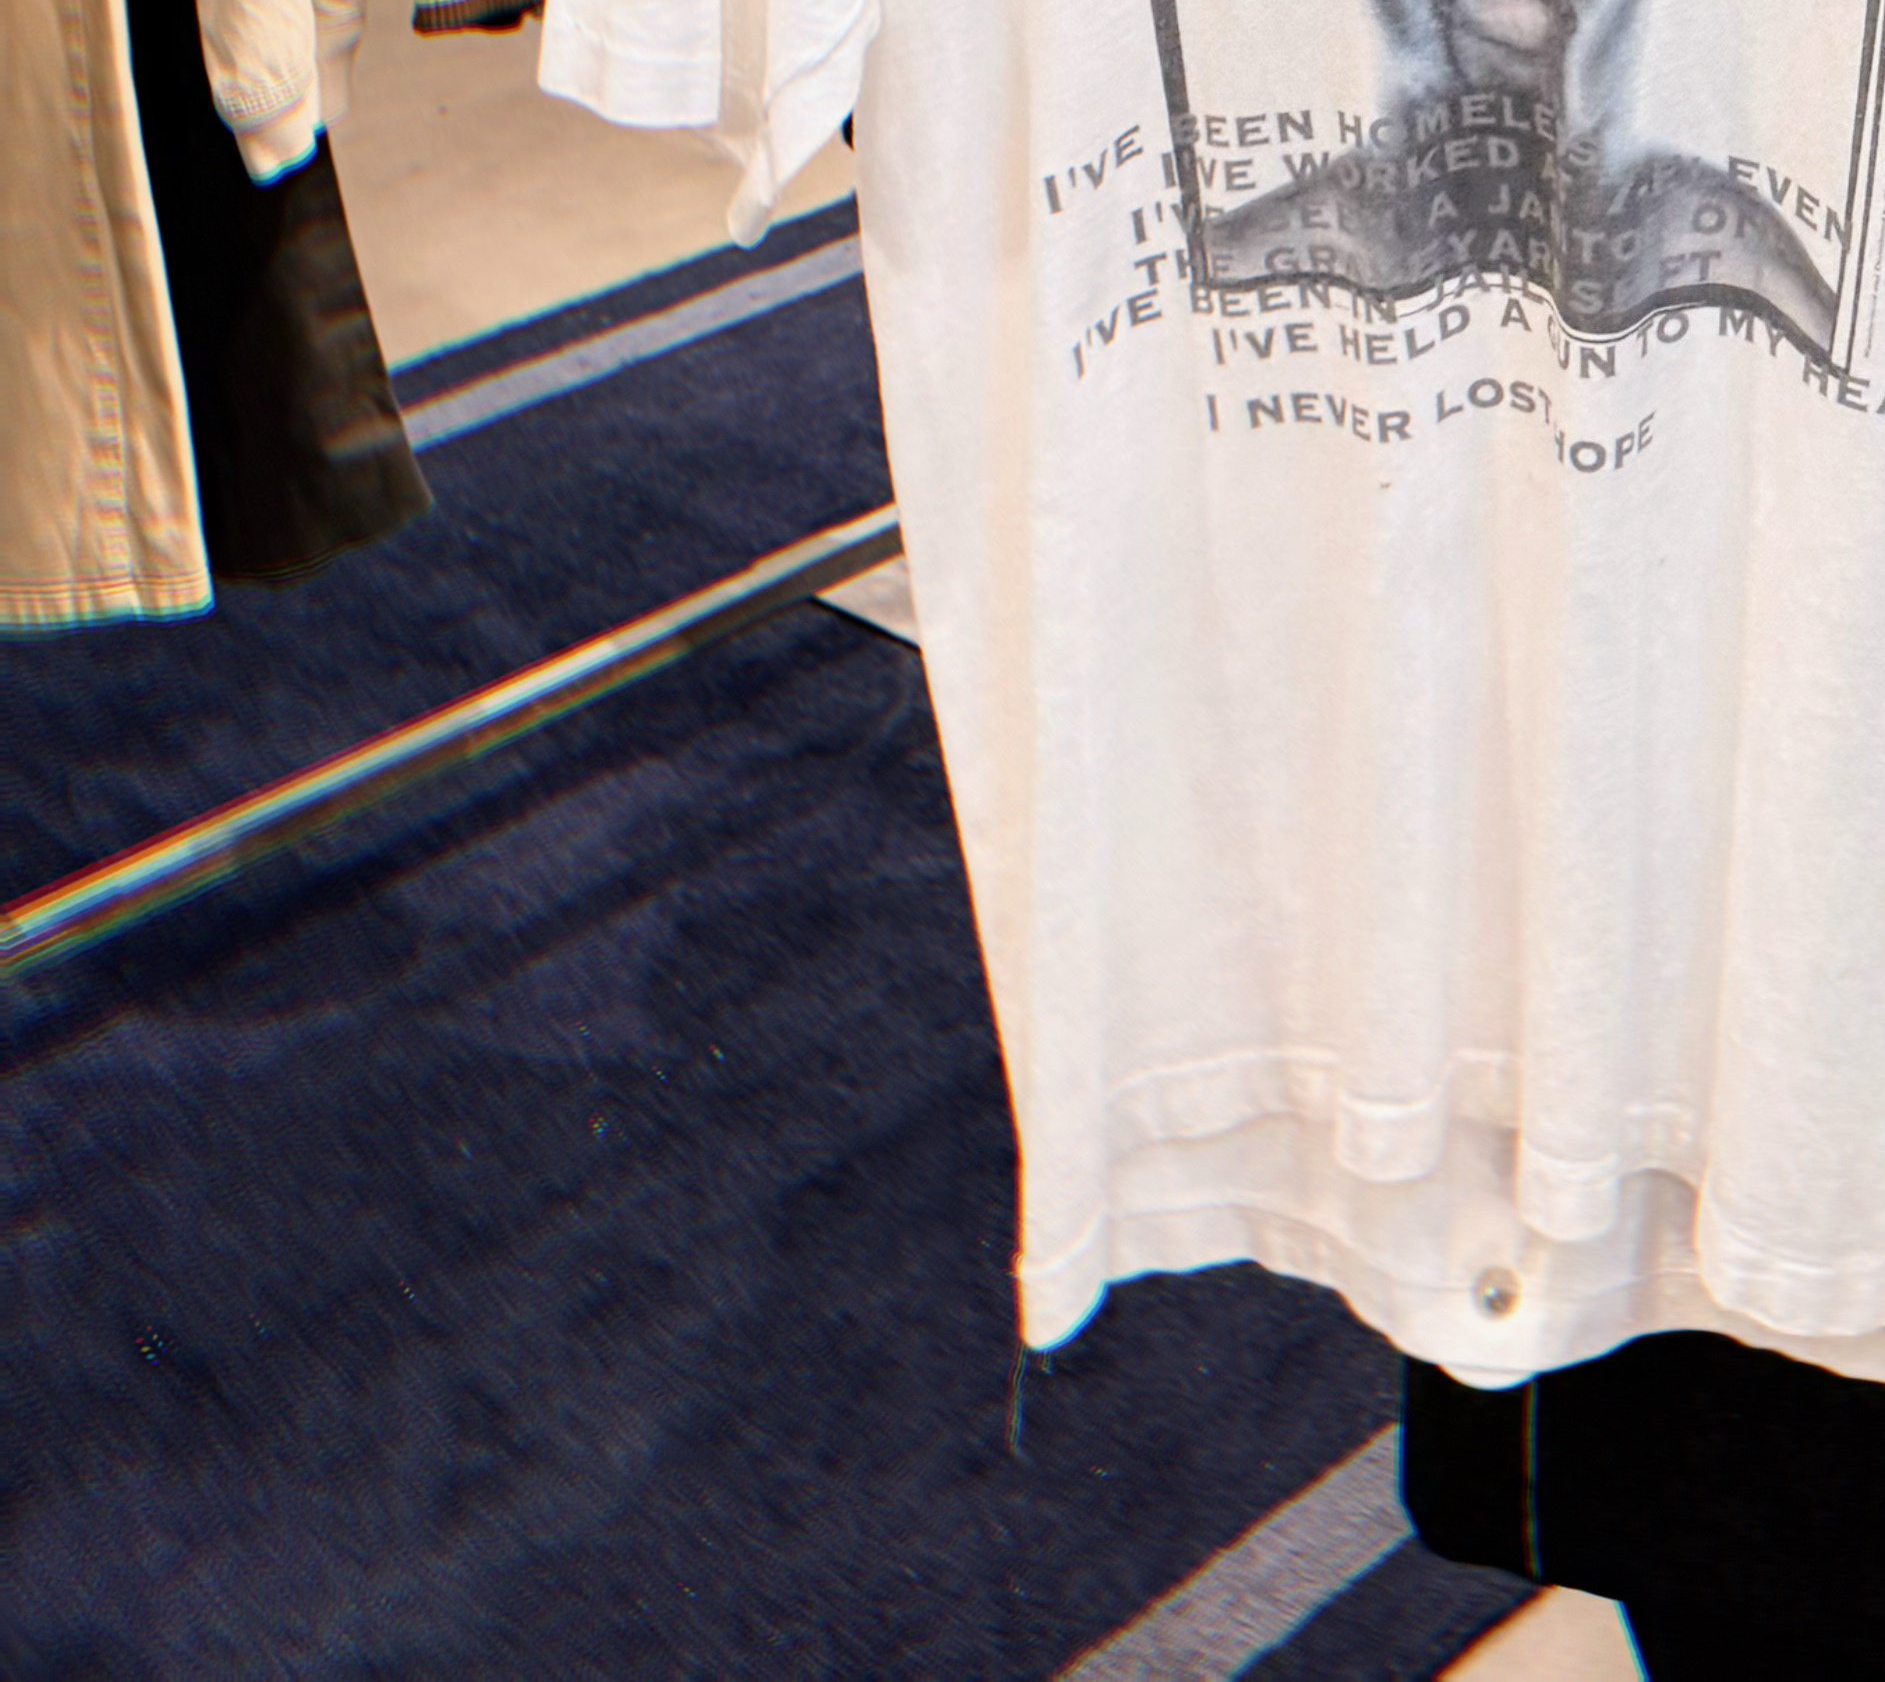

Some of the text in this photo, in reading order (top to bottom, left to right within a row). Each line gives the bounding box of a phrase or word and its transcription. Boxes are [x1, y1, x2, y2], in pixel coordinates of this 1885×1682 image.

[1043, 91, 1604, 215] I'VE BEEN HOMELES
[1284, 134, 1521, 193] WORKED
[1428, 188, 1460, 229] A
[1133, 245, 1237, 288] THE
[1071, 287, 1163, 381] I'VE
[1190, 280, 1333, 318] BEEN
[1212, 321, 1318, 367] I'VE
[1340, 303, 1471, 366] HELD
[1500, 298, 1531, 333] A
[1636, 312, 1690, 358] TO
[1717, 308, 1787, 359] MY
[1205, 393, 1220, 432] I
[1246, 390, 1414, 444] NEVER
[1435, 377, 1554, 425] LOST
